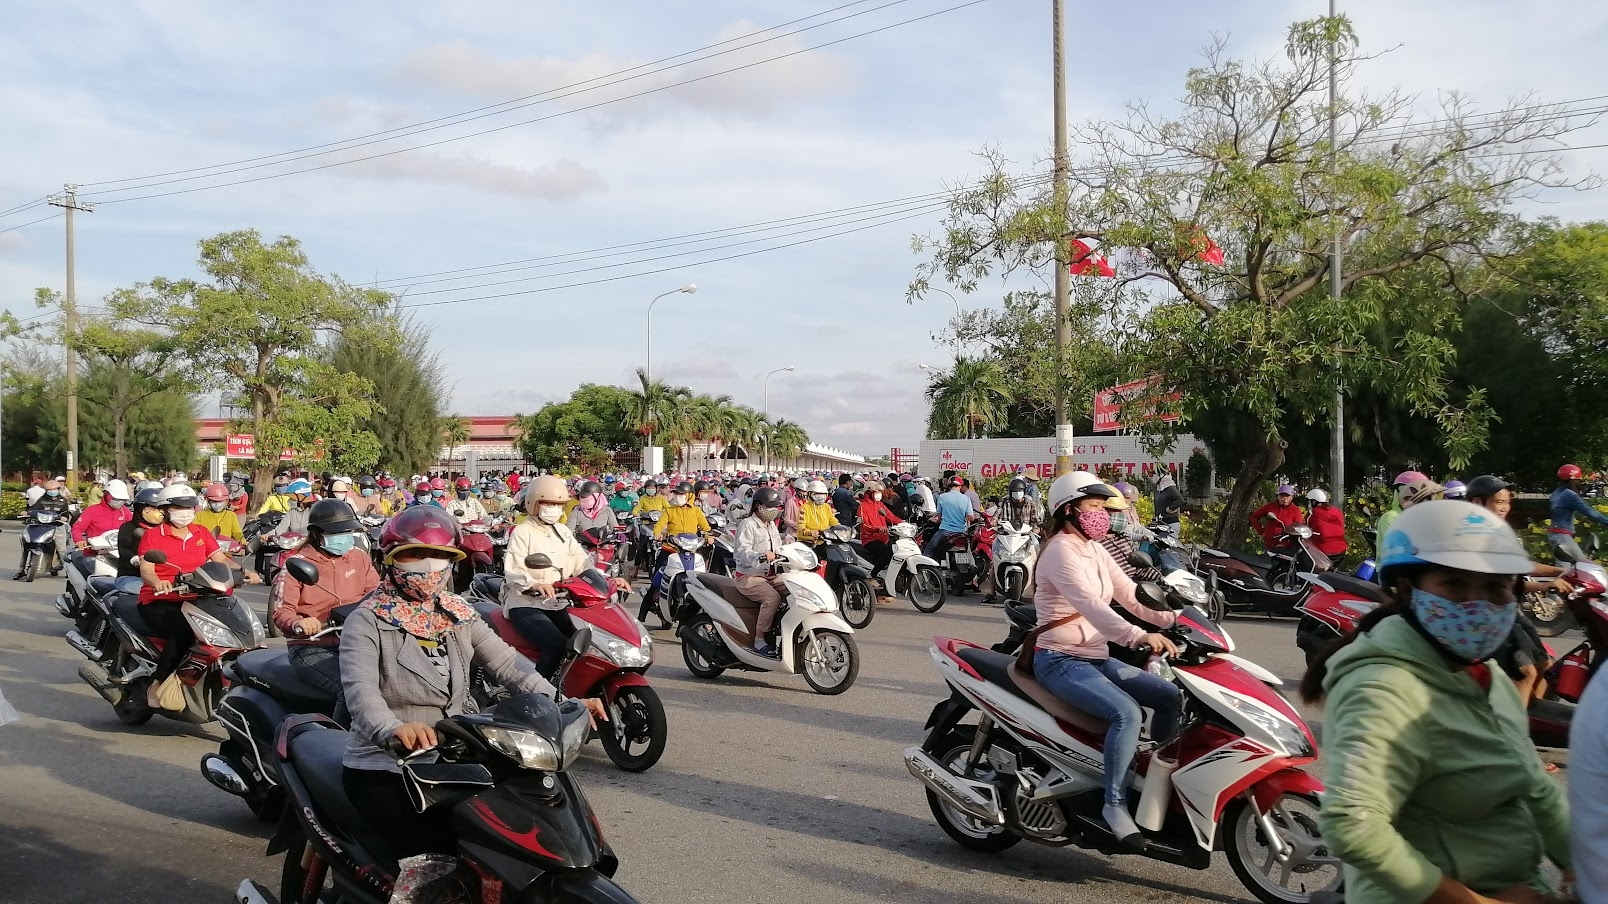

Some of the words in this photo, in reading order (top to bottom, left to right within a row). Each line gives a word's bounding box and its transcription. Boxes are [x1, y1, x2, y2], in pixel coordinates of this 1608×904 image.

[230, 437, 242, 445] TÍCH
[1090, 445, 1108, 454] TY
[940, 459, 972, 470] rieker
